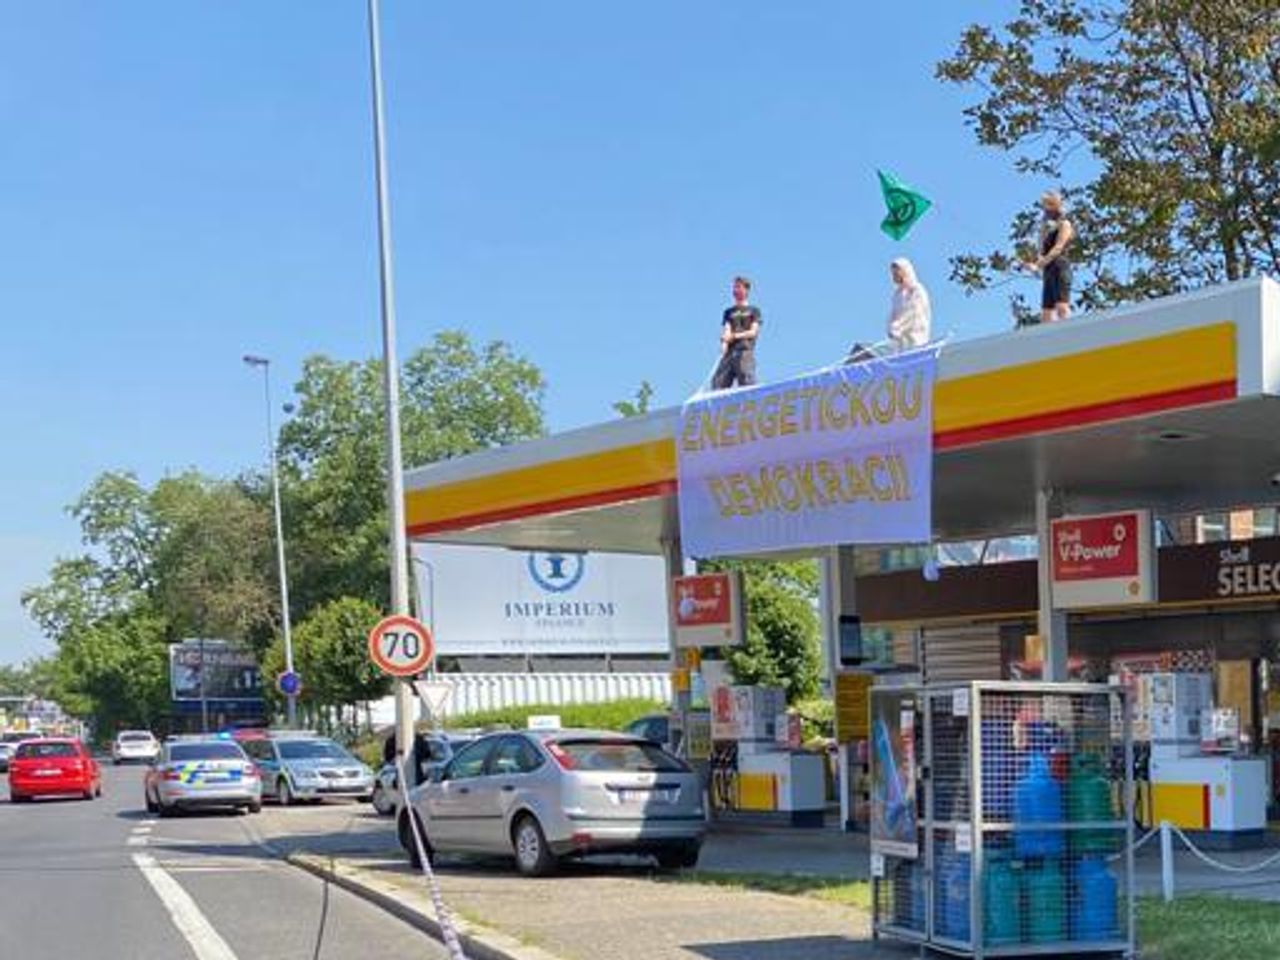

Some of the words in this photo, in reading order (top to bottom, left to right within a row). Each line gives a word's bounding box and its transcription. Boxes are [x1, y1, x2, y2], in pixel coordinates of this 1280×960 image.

[681, 371, 923, 451] ENERGETICKOU
[1060, 543, 1121, 561] V-Power
[505, 602, 615, 618] IMPERIUM
[383, 632, 419, 659] 70
